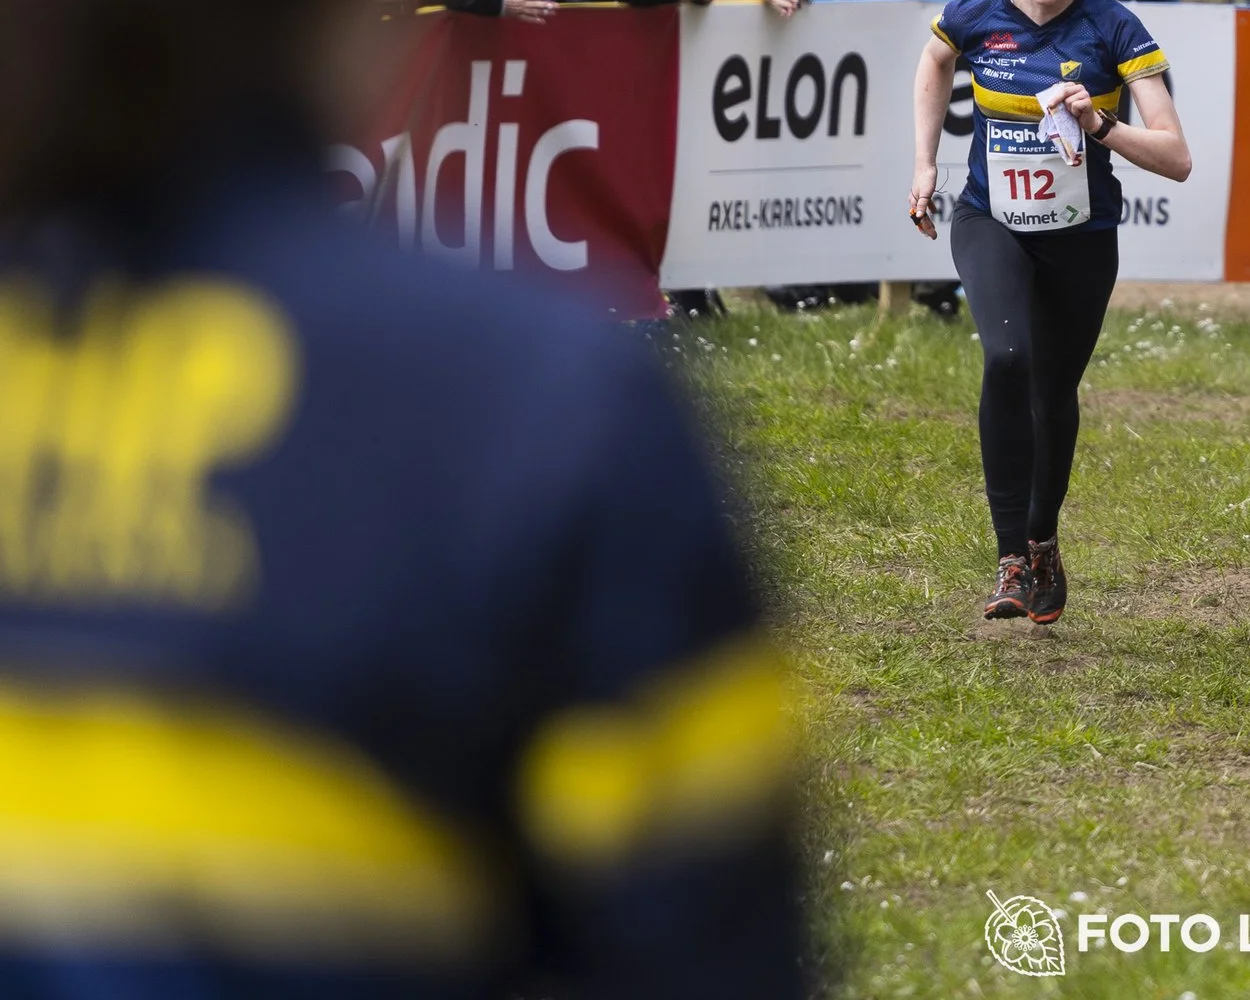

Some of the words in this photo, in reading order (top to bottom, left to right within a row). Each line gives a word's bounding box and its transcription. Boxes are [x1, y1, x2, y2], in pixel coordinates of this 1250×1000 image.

[982, 67, 1015, 81] TRIMTEX
[1003, 168, 1056, 200] 112
[708, 195, 863, 232] AXEL-KARLSSONS
[1003, 210, 1058, 226] Valmet
